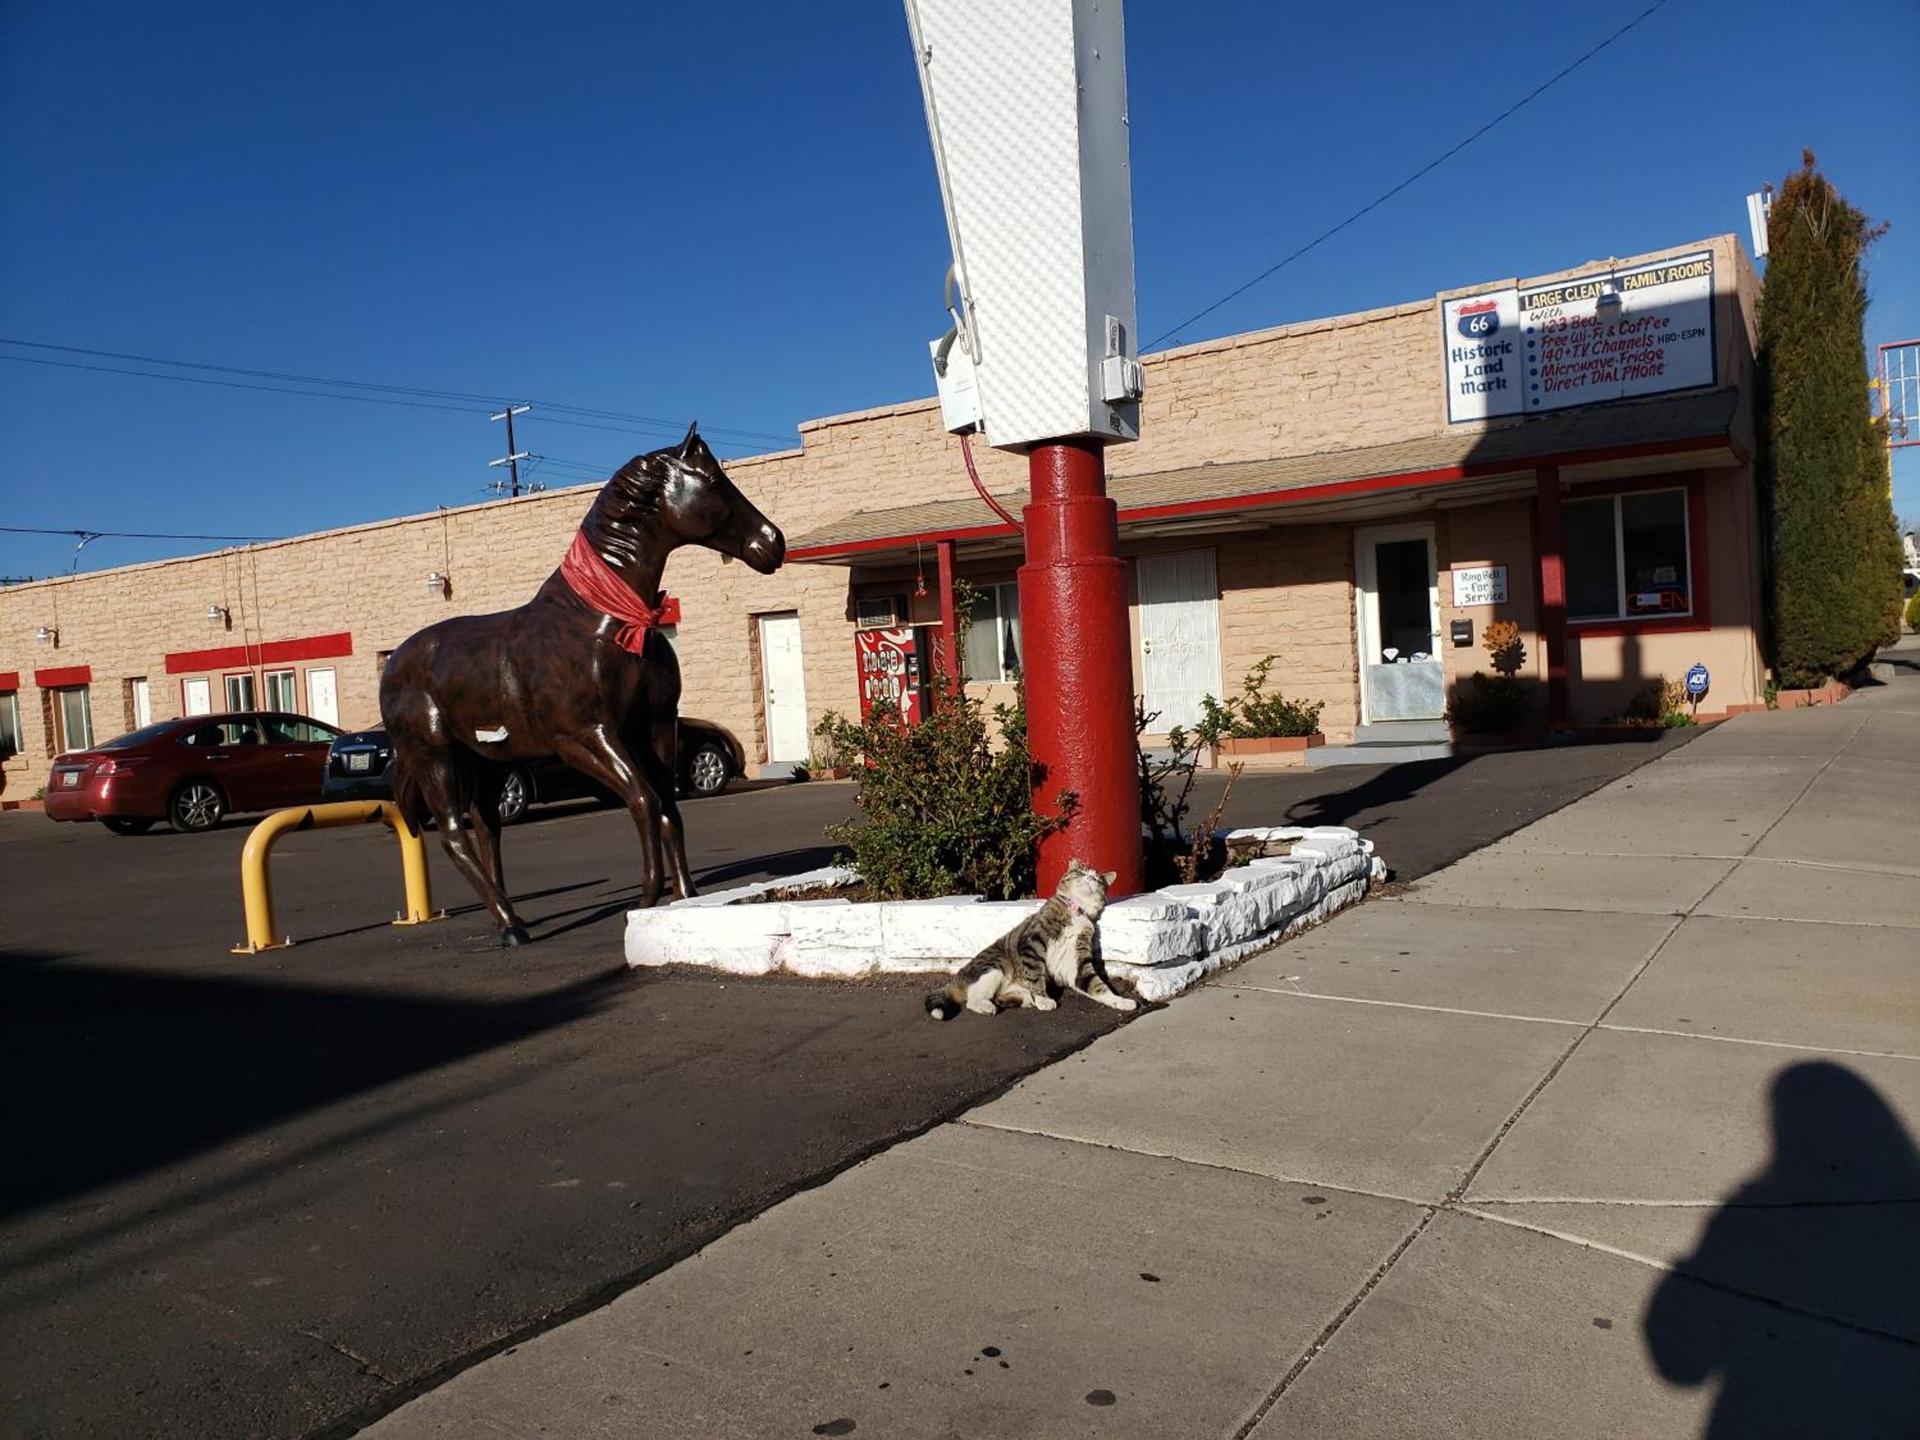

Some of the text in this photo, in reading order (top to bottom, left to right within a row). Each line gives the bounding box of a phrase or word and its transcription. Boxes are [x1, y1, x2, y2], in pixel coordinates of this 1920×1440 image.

[1525, 291, 1562, 311] LARGE
[1623, 270, 1667, 290] FAMILY
[1669, 260, 1713, 281] ROOMS
[1470, 316, 1489, 333] 66
[1541, 334, 1568, 349] Free
[1570, 326, 1604, 344] Wi-Fi
[1619, 315, 1670, 335] Coffee
[1452, 340, 1514, 363] Historic
[1591, 333, 1654, 356] Channels
[1464, 358, 1505, 379] Land
[1543, 371, 1588, 393] Direct
[1461, 569, 1500, 582] Ring Bell
[1464, 591, 1505, 604] Service
[1626, 591, 1688, 613] OEN
[1689, 672, 1707, 685] ADT
